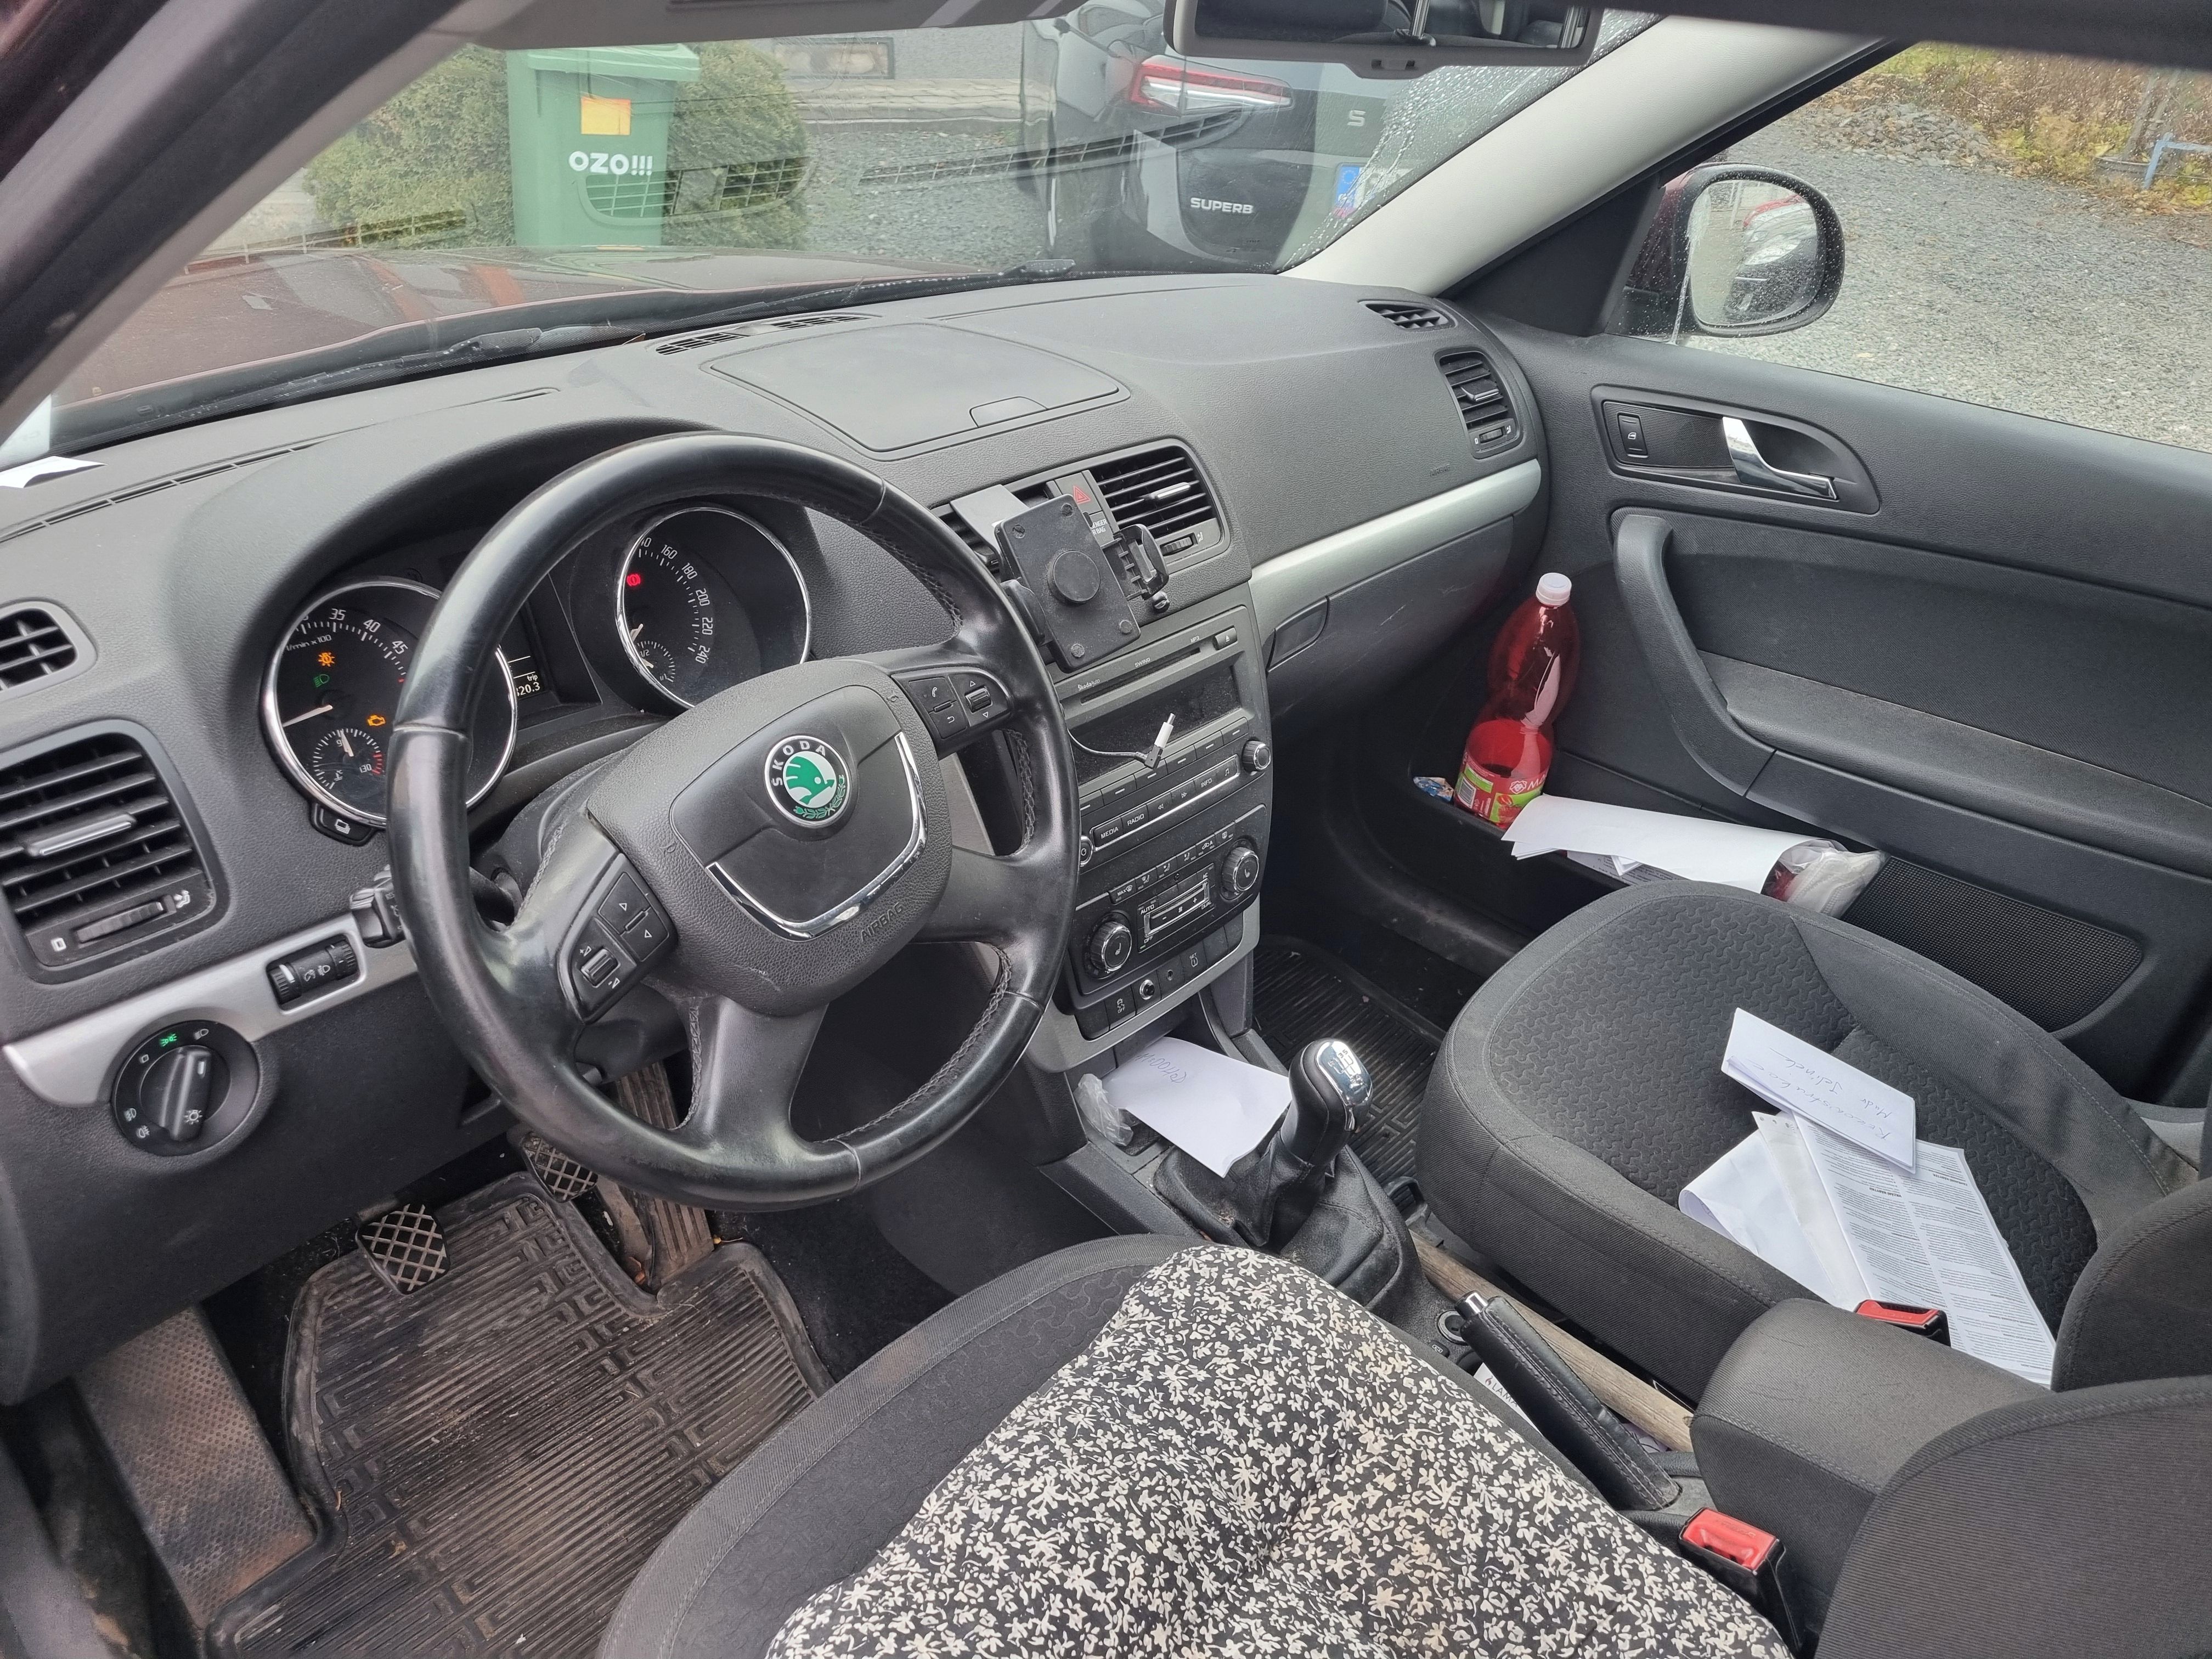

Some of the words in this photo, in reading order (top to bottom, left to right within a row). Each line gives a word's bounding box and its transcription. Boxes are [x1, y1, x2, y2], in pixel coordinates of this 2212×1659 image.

[568, 150, 653, 176] OZO!!!
[1190, 197, 1254, 214] SUPERB
[661, 544, 678, 560] 160
[681, 562, 698, 579] 180
[695, 588, 710, 606] 200
[329, 608, 346, 620] 35
[363, 618, 381, 633] 40
[702, 617, 713, 635] 220
[391, 640, 408, 654] 45
[695, 645, 710, 664] 240
[1134, 657, 1151, 668] SWING
[359, 764, 372, 773] 130
[1200, 777, 1213, 789] INFO
[1101, 827, 1119, 839] MEDIA
[1127, 813, 1145, 826] RADIO
[1140, 904, 1155, 915] AUTO
[860, 901, 905, 943] AIRBAG
[1144, 935, 1153, 944] OFF
